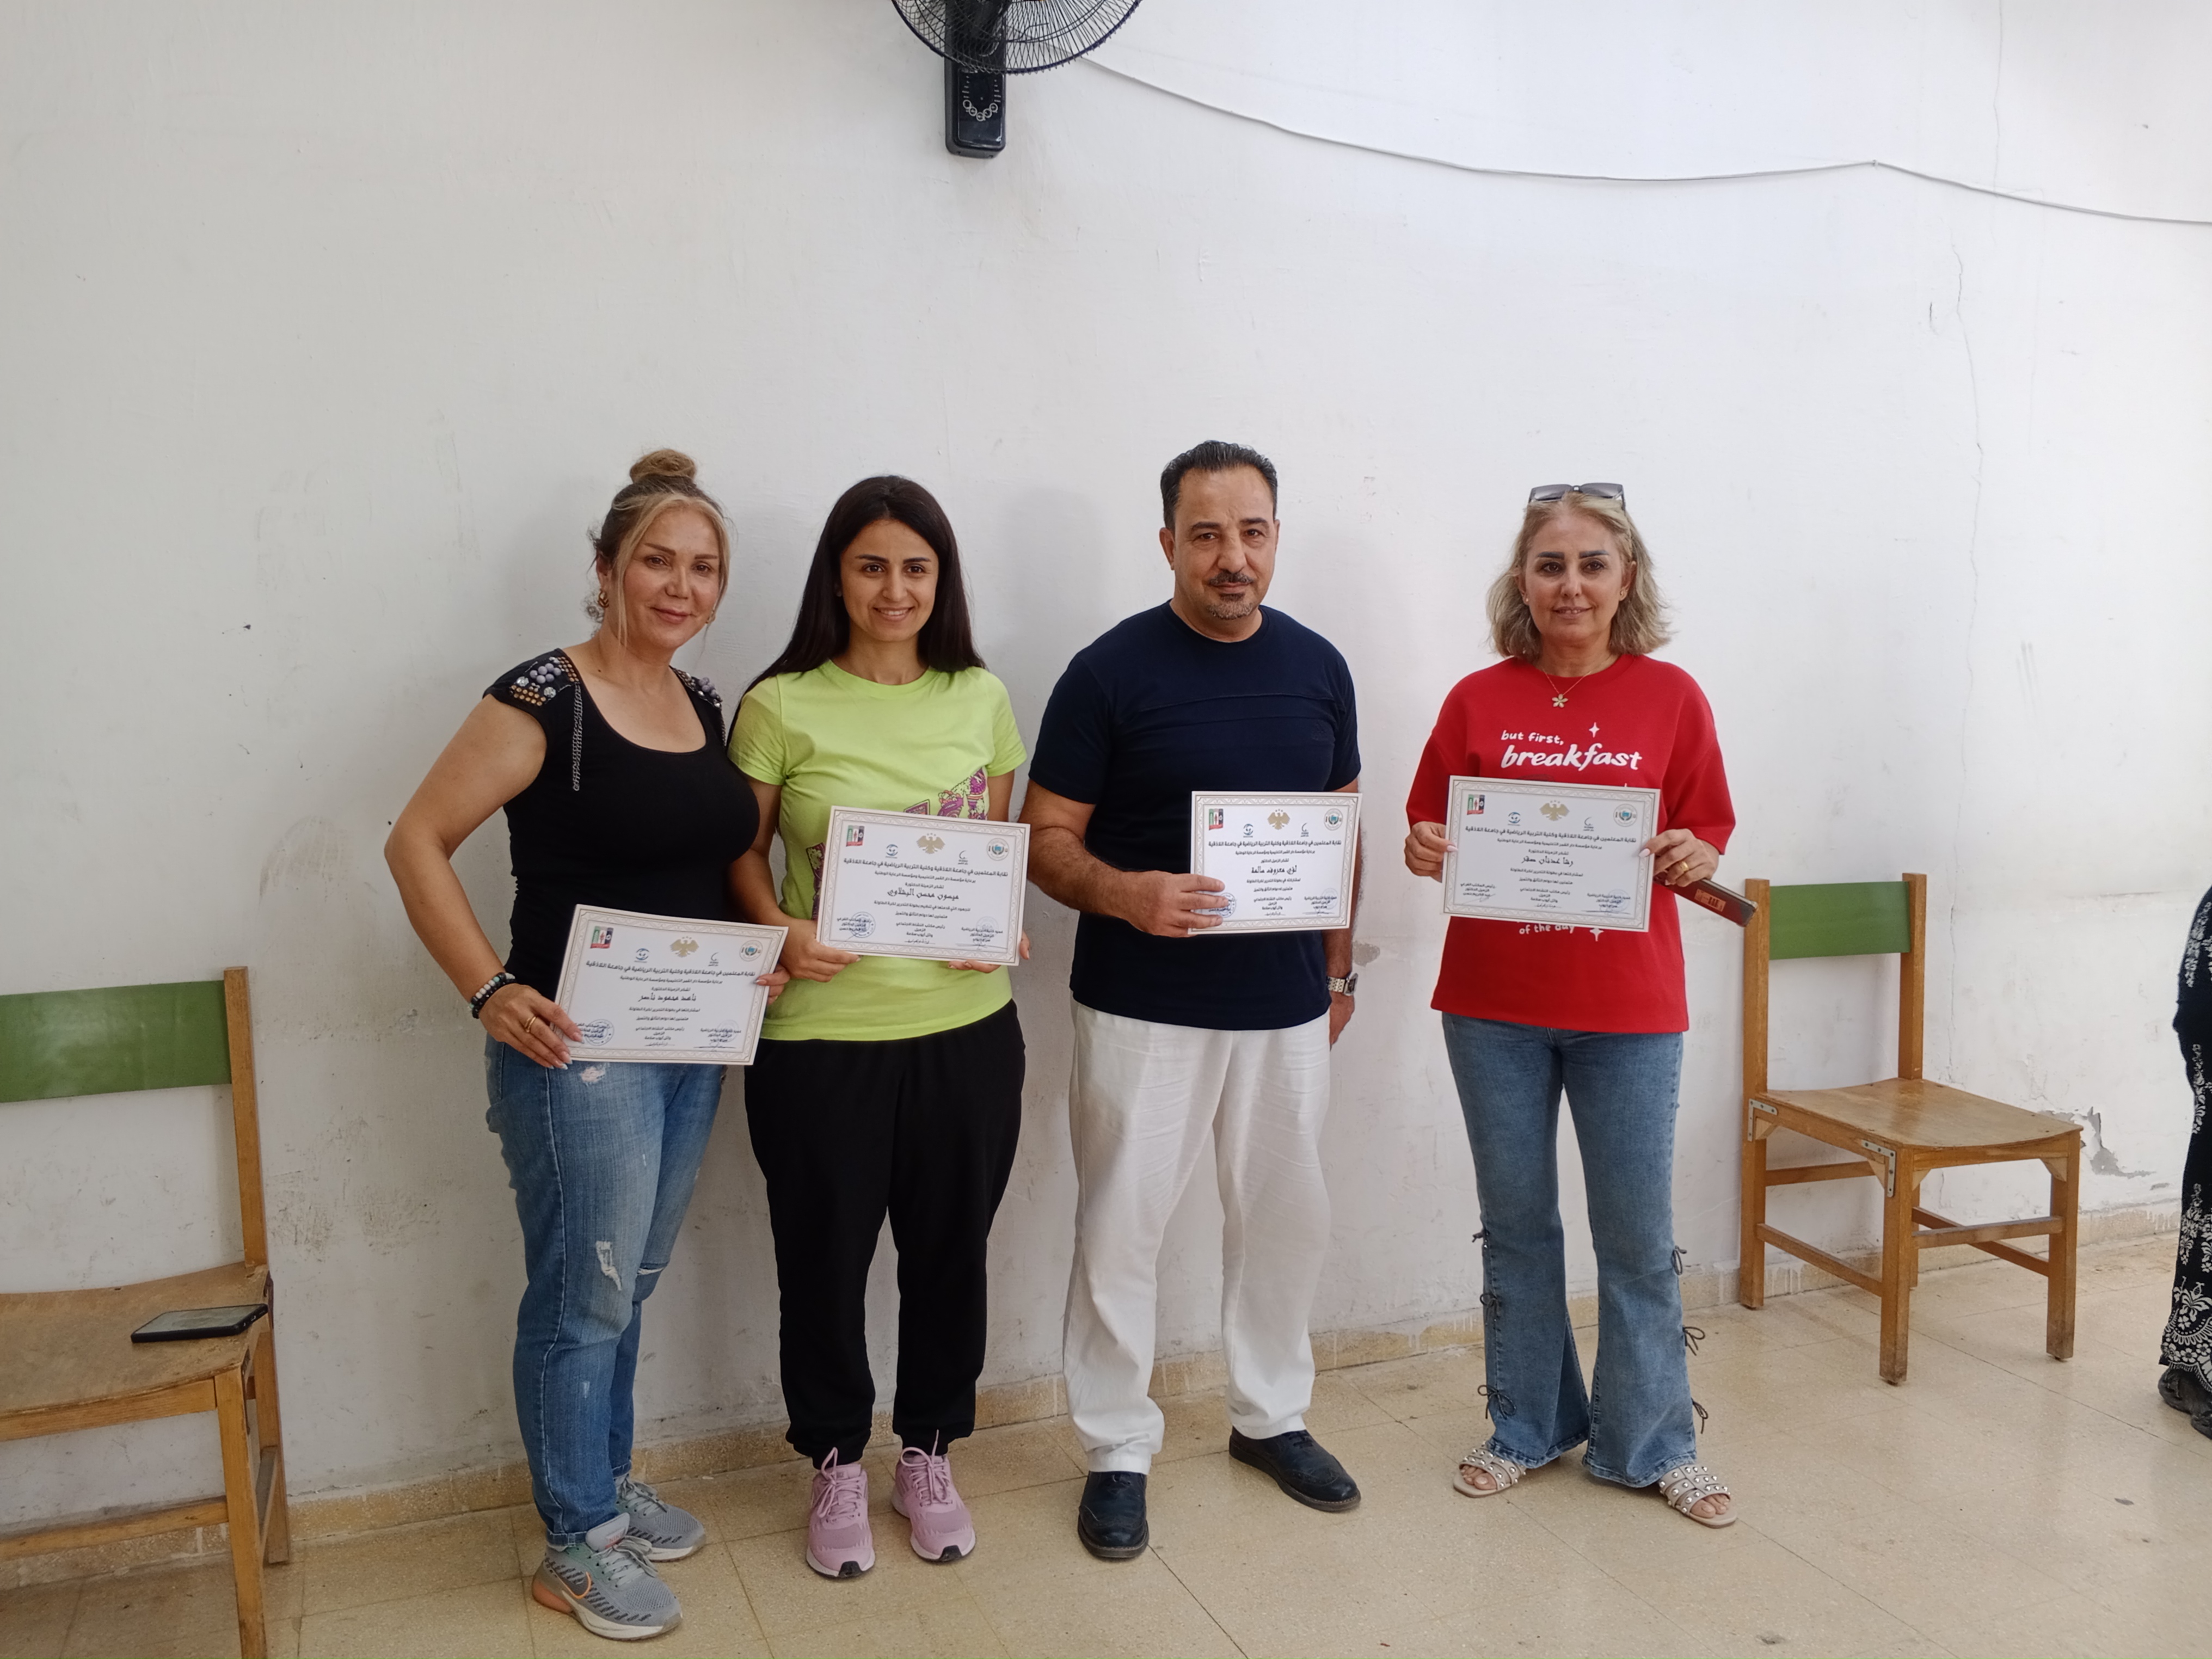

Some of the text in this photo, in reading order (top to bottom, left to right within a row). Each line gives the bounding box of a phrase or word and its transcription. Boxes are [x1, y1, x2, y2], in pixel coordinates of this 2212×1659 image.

[1501, 730, 1564, 746] but first,
[1501, 743, 1643, 771] breakfast
[1519, 924, 1531, 935] of
[1534, 924, 1551, 933] the
